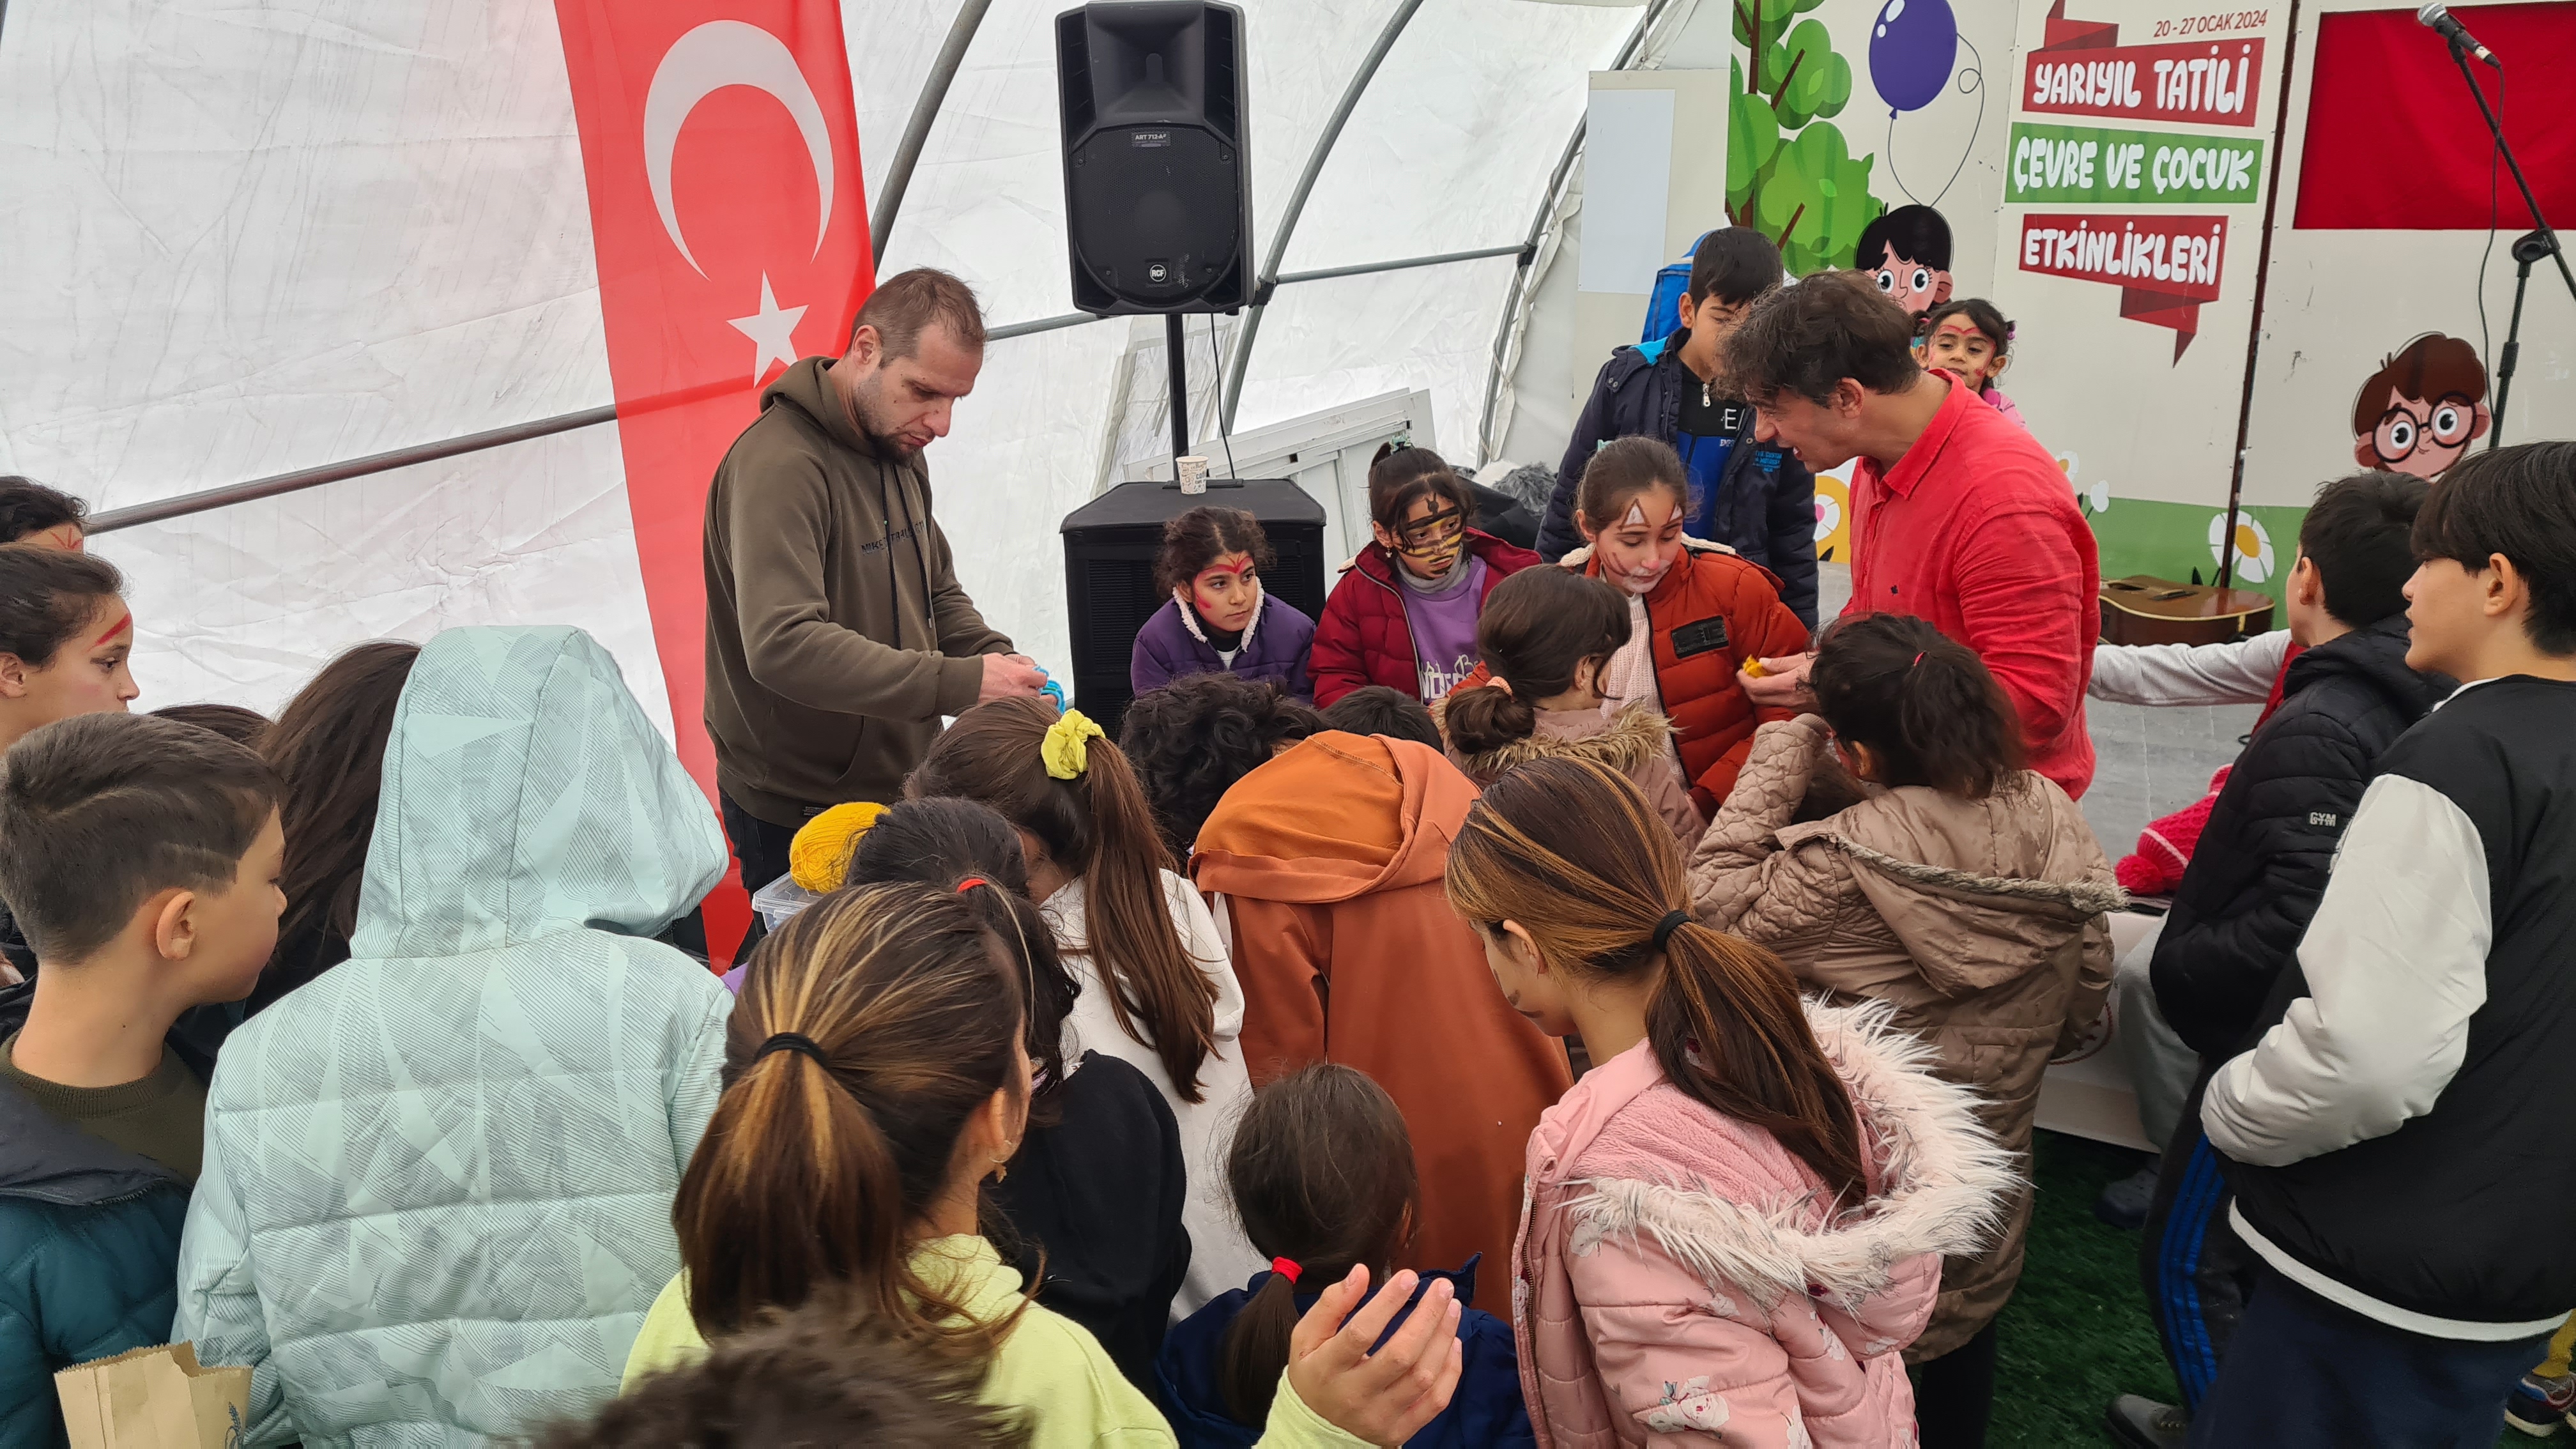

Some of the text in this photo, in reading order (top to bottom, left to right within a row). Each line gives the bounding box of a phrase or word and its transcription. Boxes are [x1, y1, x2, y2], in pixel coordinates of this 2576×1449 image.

[2153, 20, 2171, 38] 20
[2179, 17, 2196, 35] 27
[2196, 12, 2235, 33] OCAK
[2234, 9, 2269, 29] 2024
[2033, 44, 2251, 114] YARIYIL TATİLİ
[2013, 135, 2255, 194] ÇEVRE VE ÇOCUK
[1151, 269, 1164, 277] RCF
[2025, 219, 2221, 286] ETKİNLİKLERİ
[2309, 811, 2337, 827] GYM
